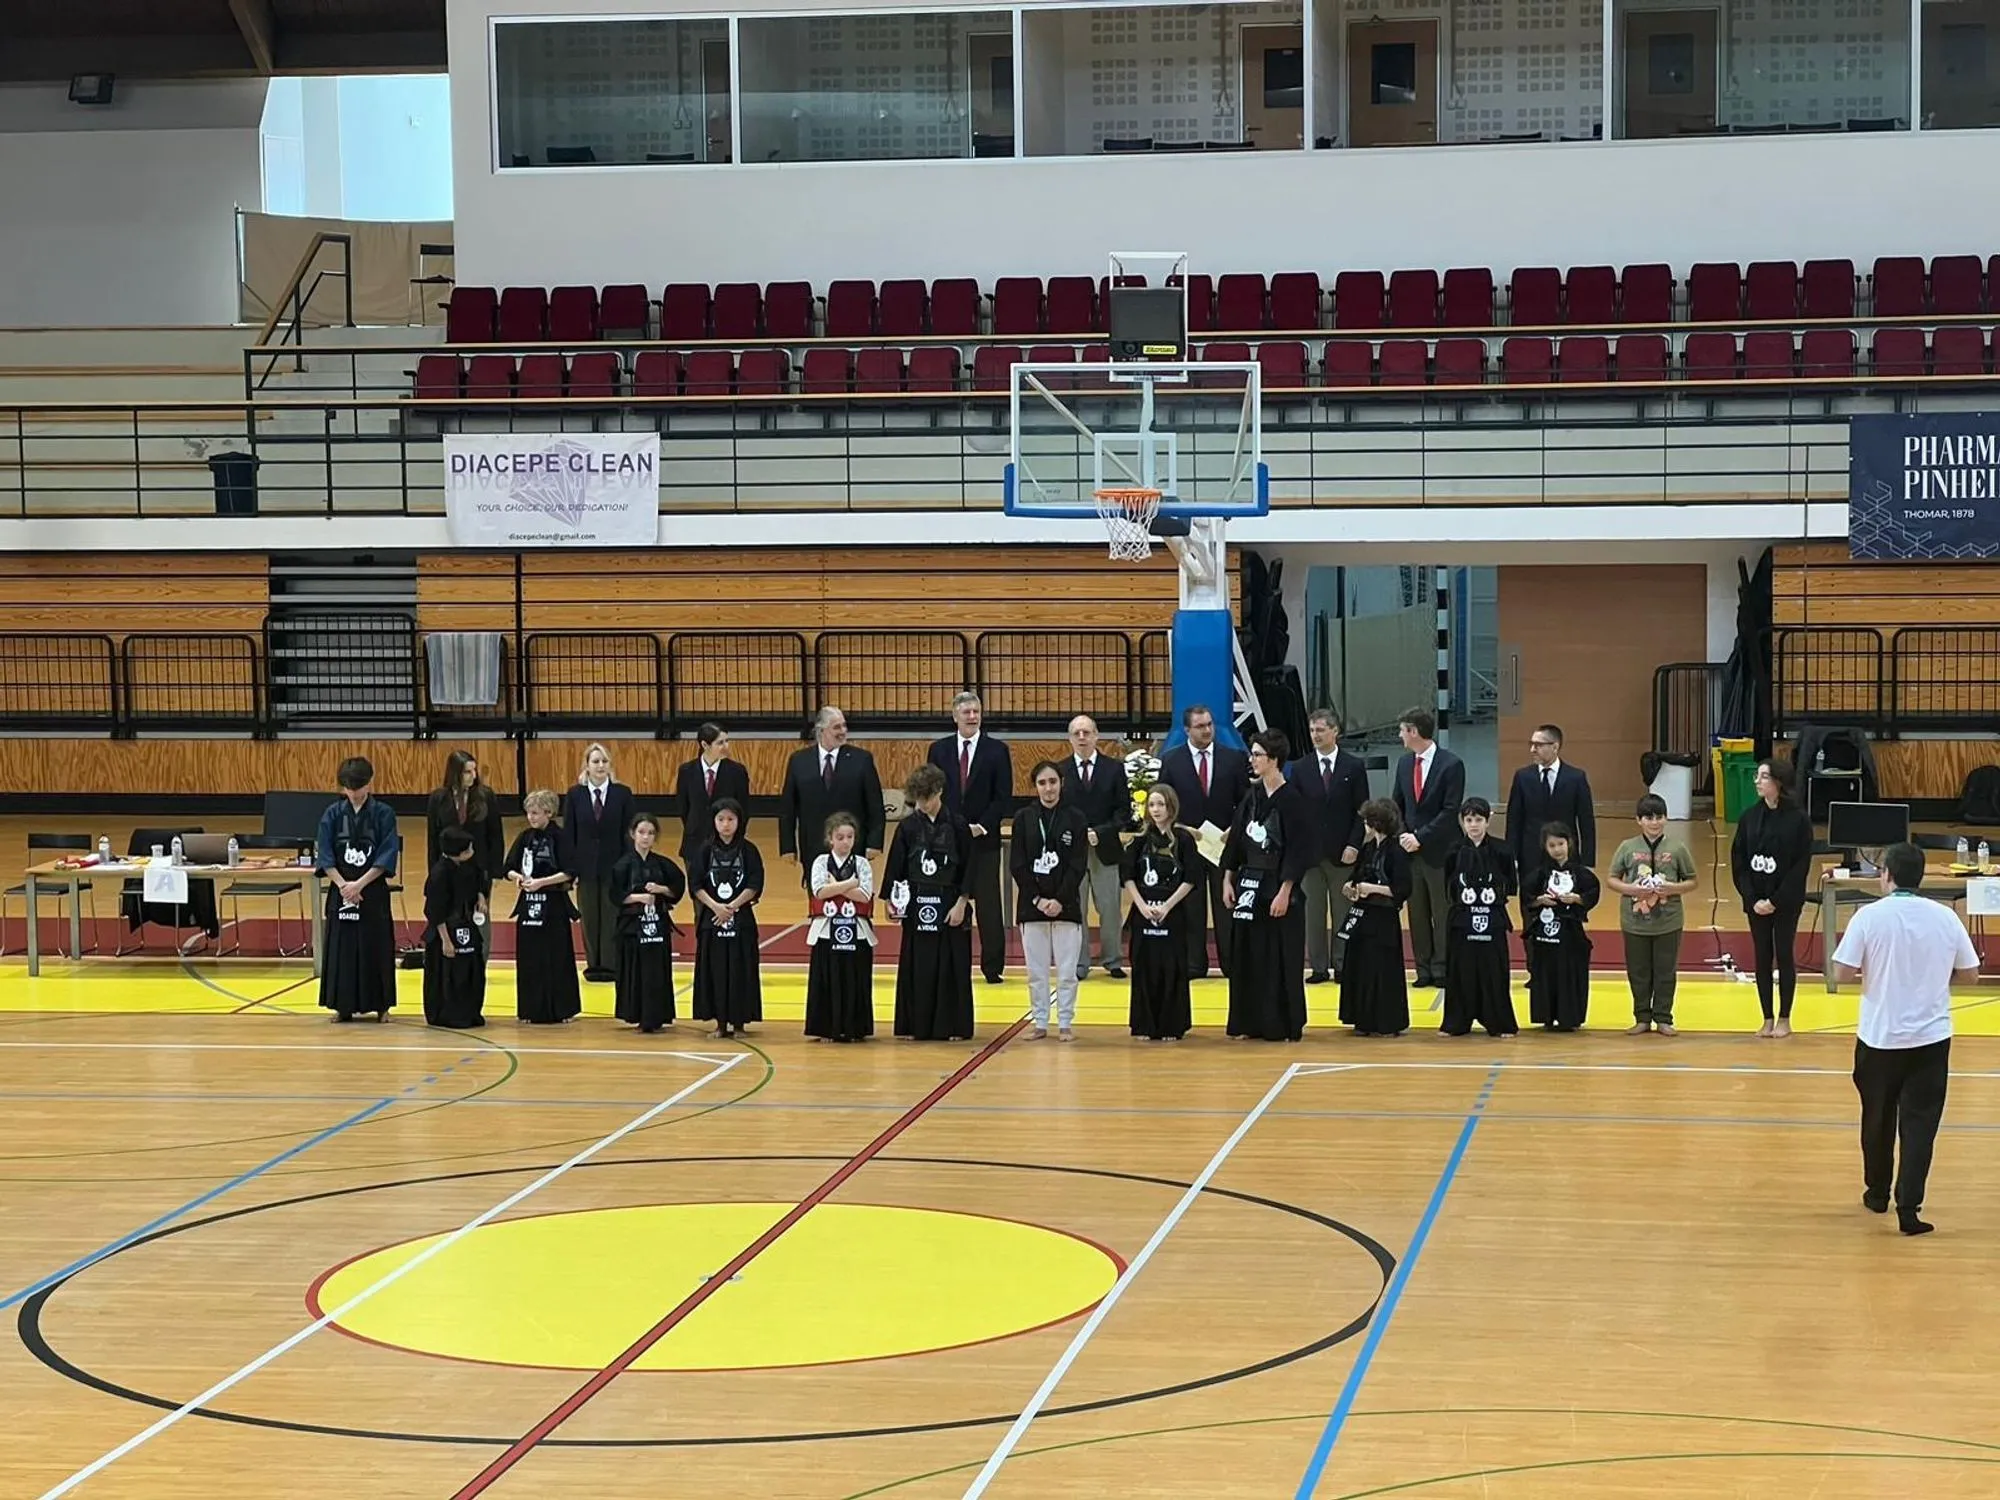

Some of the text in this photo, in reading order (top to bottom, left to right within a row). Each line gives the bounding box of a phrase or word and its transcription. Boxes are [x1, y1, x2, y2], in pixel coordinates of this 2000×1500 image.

[1904, 435, 2000, 466] PHARM
[451, 452, 653, 474] DIACEPE CLEAN
[1904, 468, 2000, 499] PINHEI
[477, 503, 501, 512] YOUR
[544, 503, 565, 512] OUR
[568, 503, 628, 512] DEDICATION!
[1904, 509, 1975, 519] THOMAR, 1878
[508, 532, 596, 541] diacepeclean@gmail.com
[154, 873, 175, 892] A
